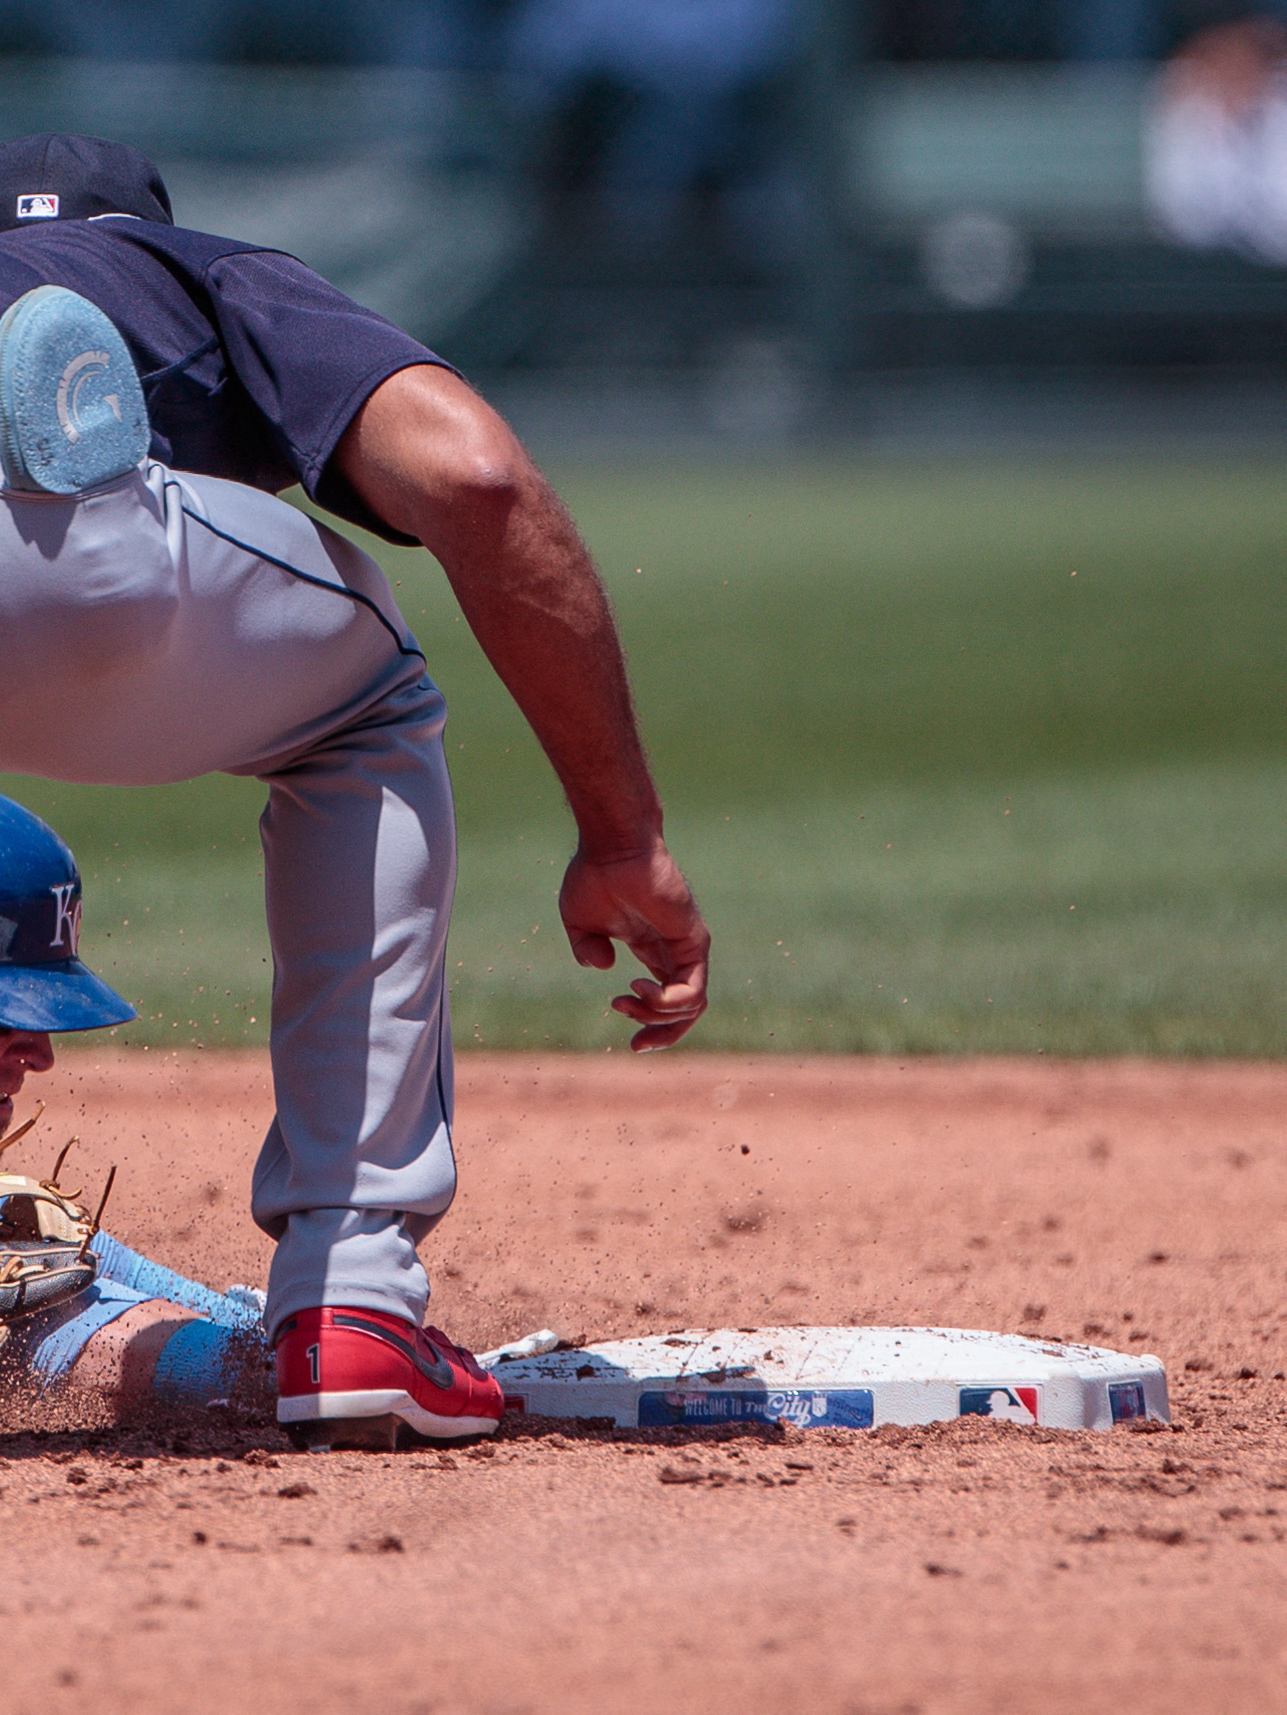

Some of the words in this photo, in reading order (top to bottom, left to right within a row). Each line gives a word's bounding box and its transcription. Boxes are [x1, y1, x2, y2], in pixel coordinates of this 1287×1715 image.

[306, 1344, 320, 1383] 1
[684, 1397, 728, 1416] WELCOME
[730, 1398, 742, 1416] TO
[764, 1391, 812, 1427] City
